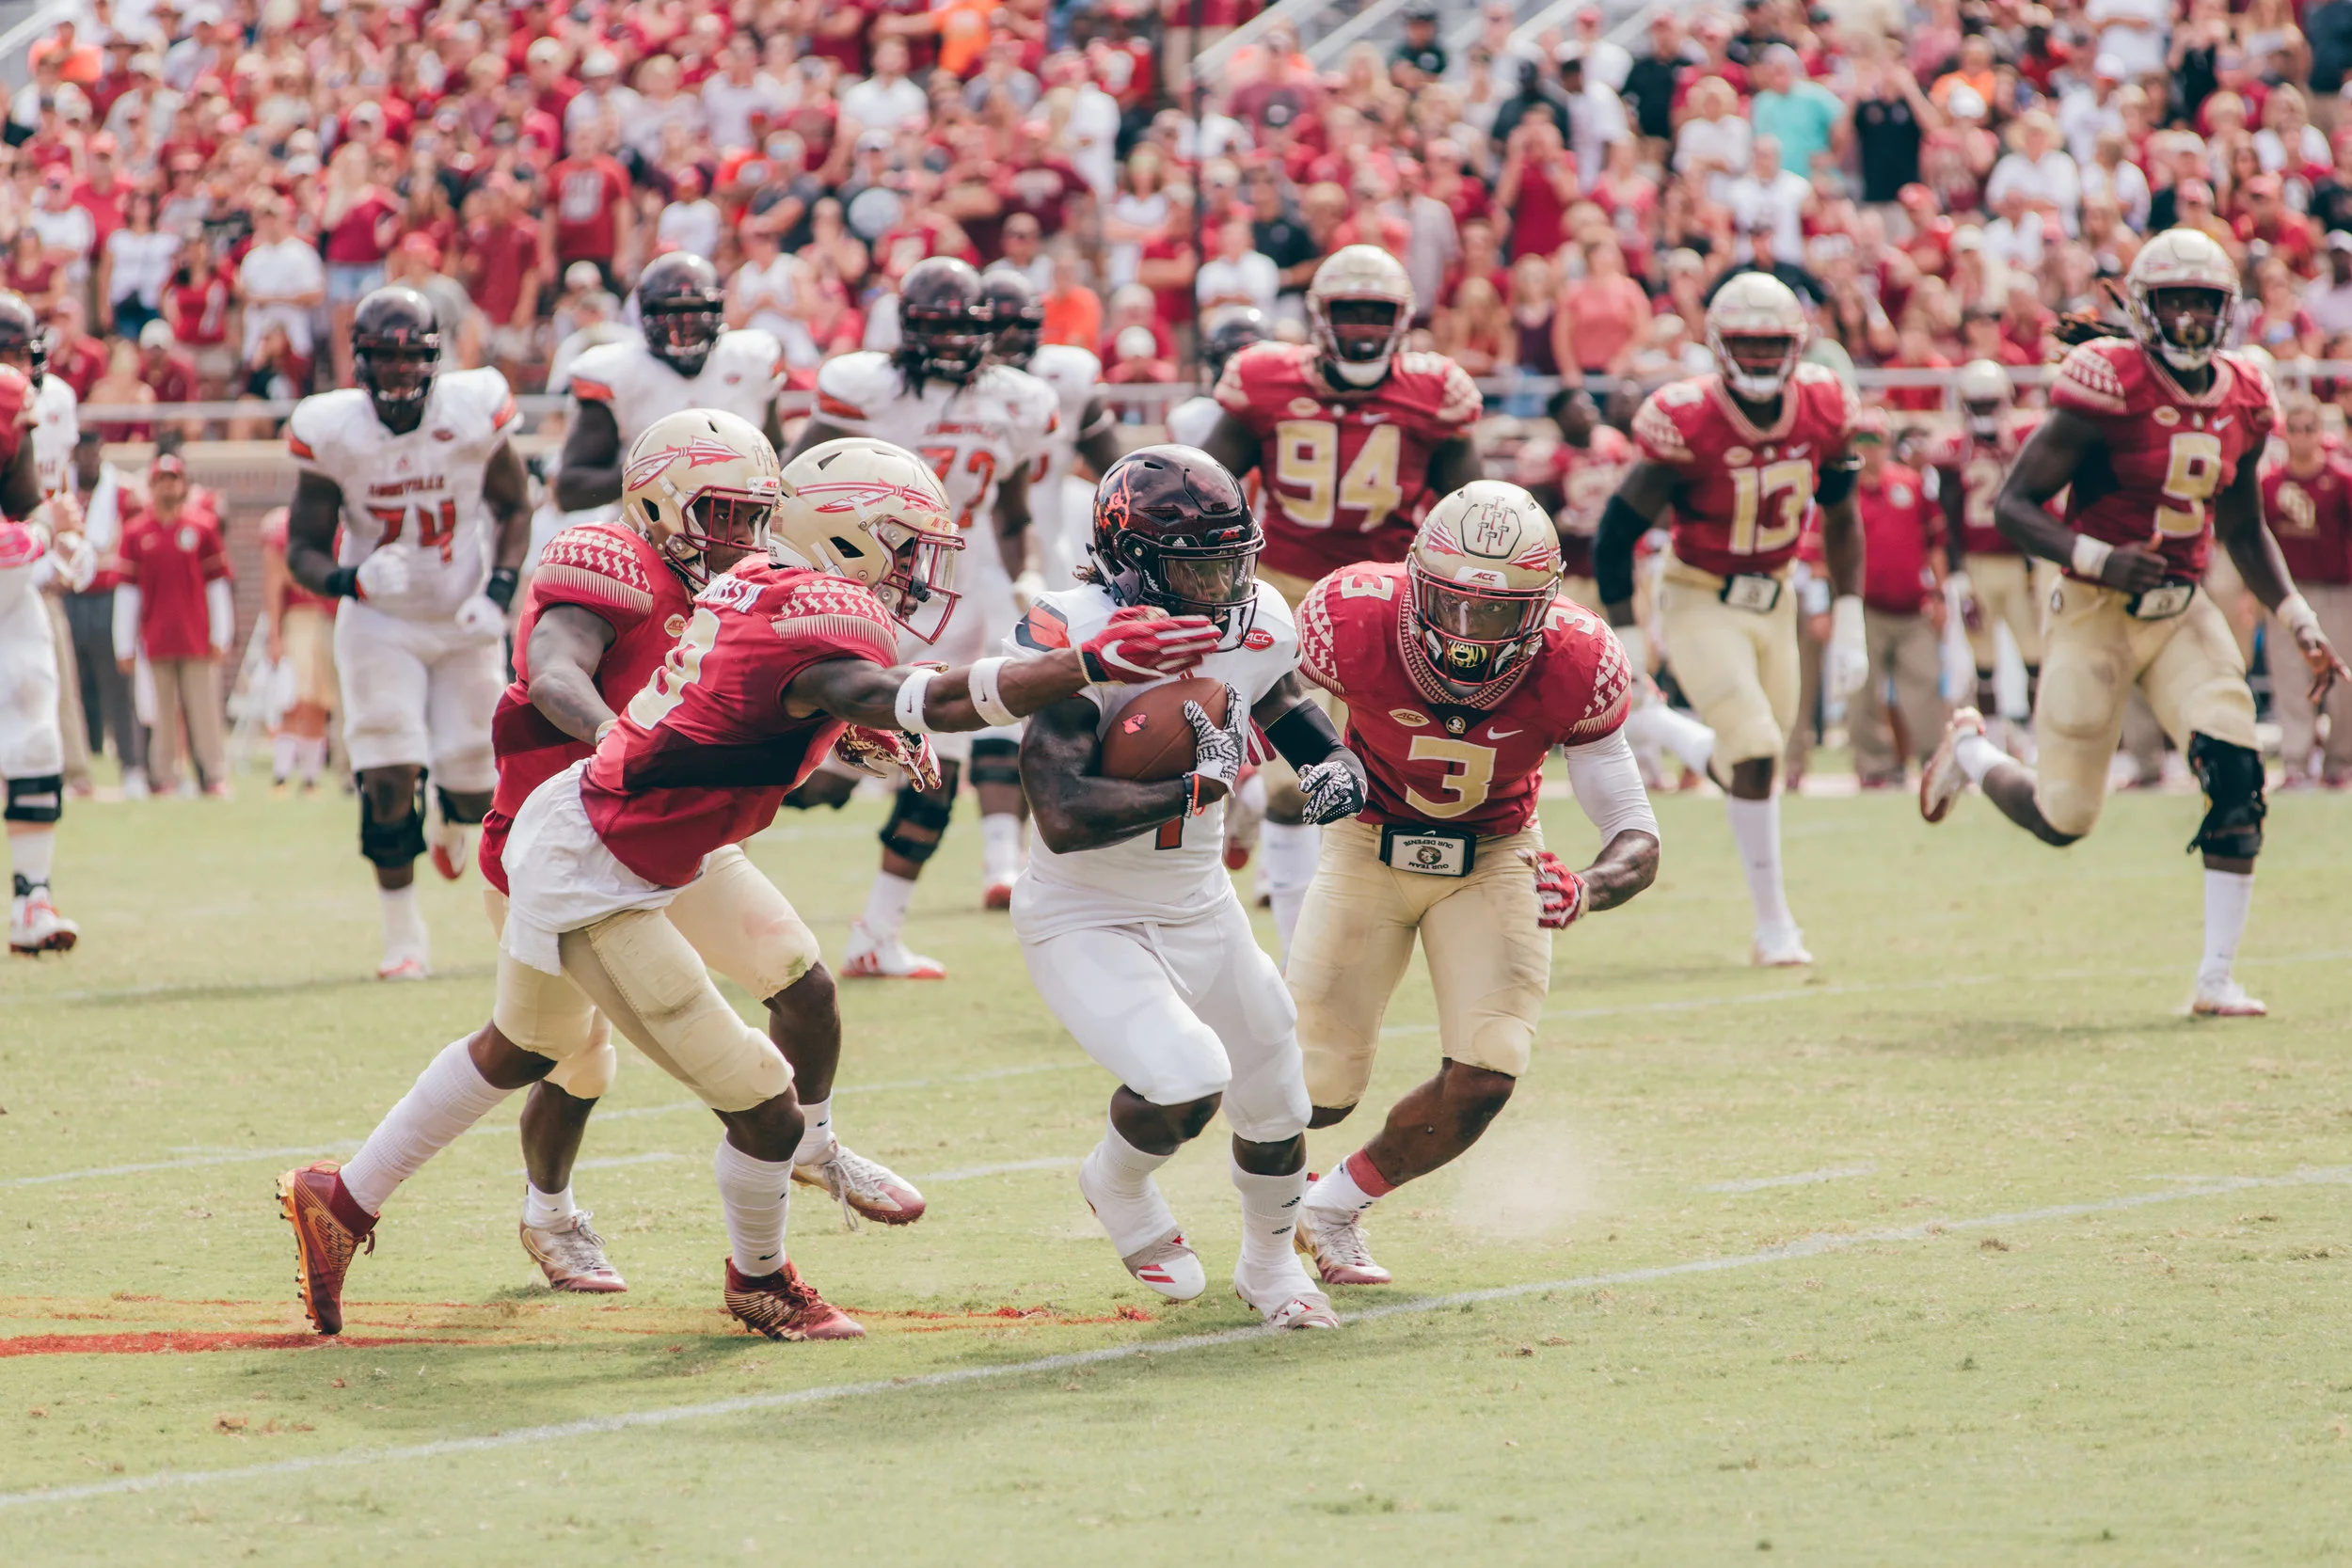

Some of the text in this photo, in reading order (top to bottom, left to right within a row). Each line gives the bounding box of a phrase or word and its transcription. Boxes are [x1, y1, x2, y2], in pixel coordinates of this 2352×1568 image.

[1275, 420, 1403, 532] 94
[2154, 432, 2222, 538] 9
[1728, 459, 1814, 556] 13
[364, 499, 455, 562] 74
[1341, 575, 1393, 601] 3
[1472, 572, 1497, 581] ACC
[667, 620, 684, 629] ACC
[1245, 633, 1271, 643] ACC
[1393, 712, 1422, 723] ACC
[1405, 735, 1498, 819] 3
